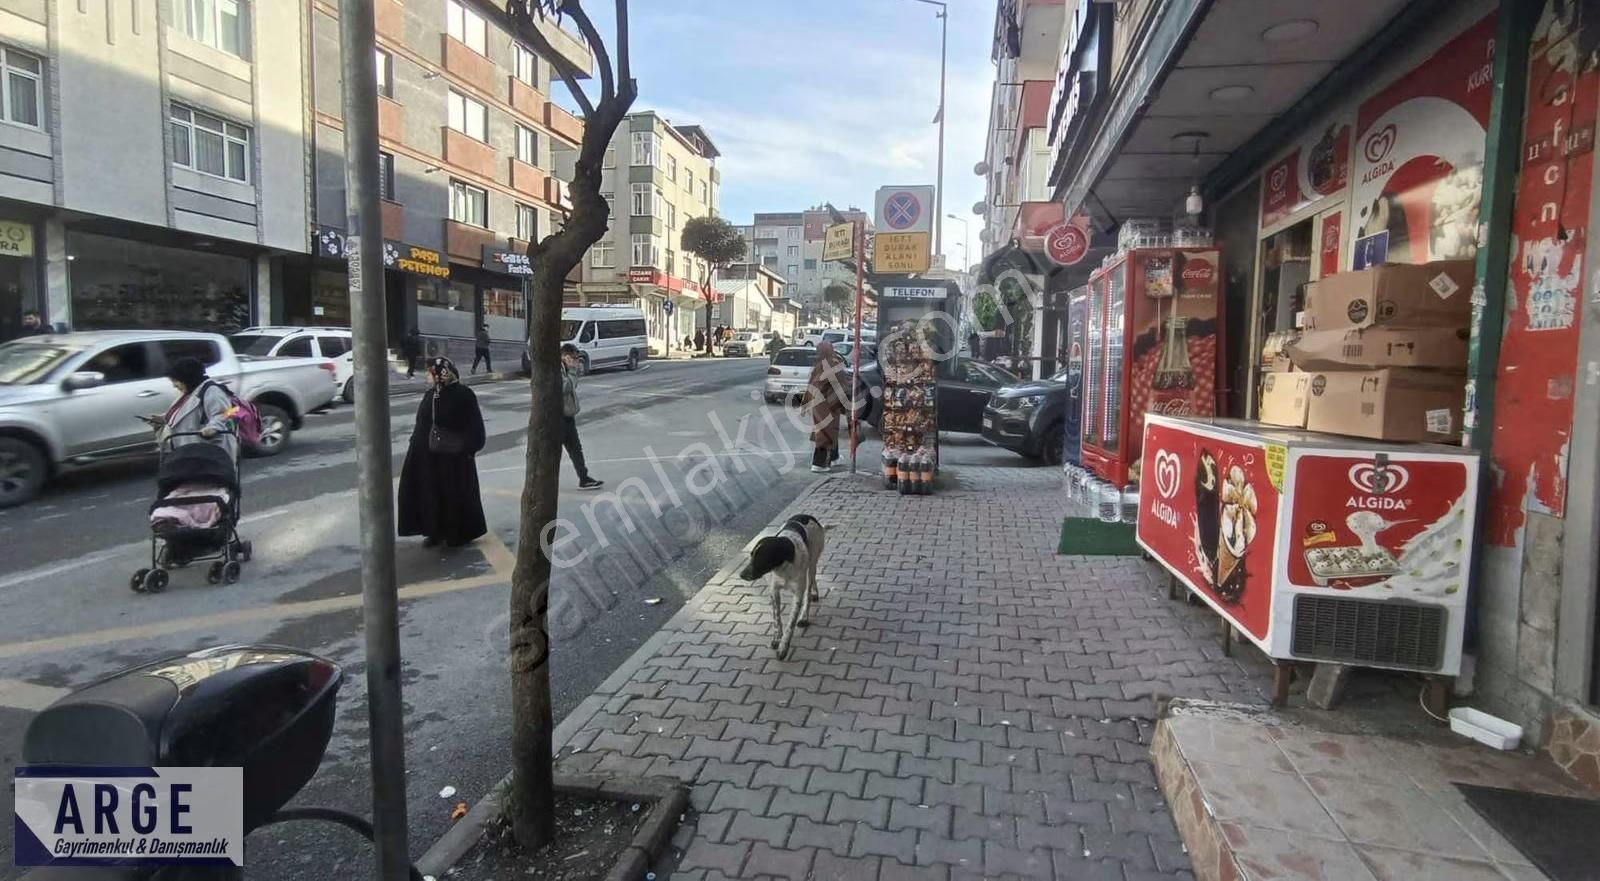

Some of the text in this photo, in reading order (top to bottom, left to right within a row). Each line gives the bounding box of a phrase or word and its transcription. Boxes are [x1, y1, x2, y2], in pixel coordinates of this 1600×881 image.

[884, 244, 918, 252] DURAK
[397, 258, 450, 280] PETSHOP
[887, 261, 913, 269] SONU
[892, 287, 936, 297] TELEFON
[1345, 496, 1406, 511] ALGiDA
[1151, 498, 1178, 529] ALGiDA
